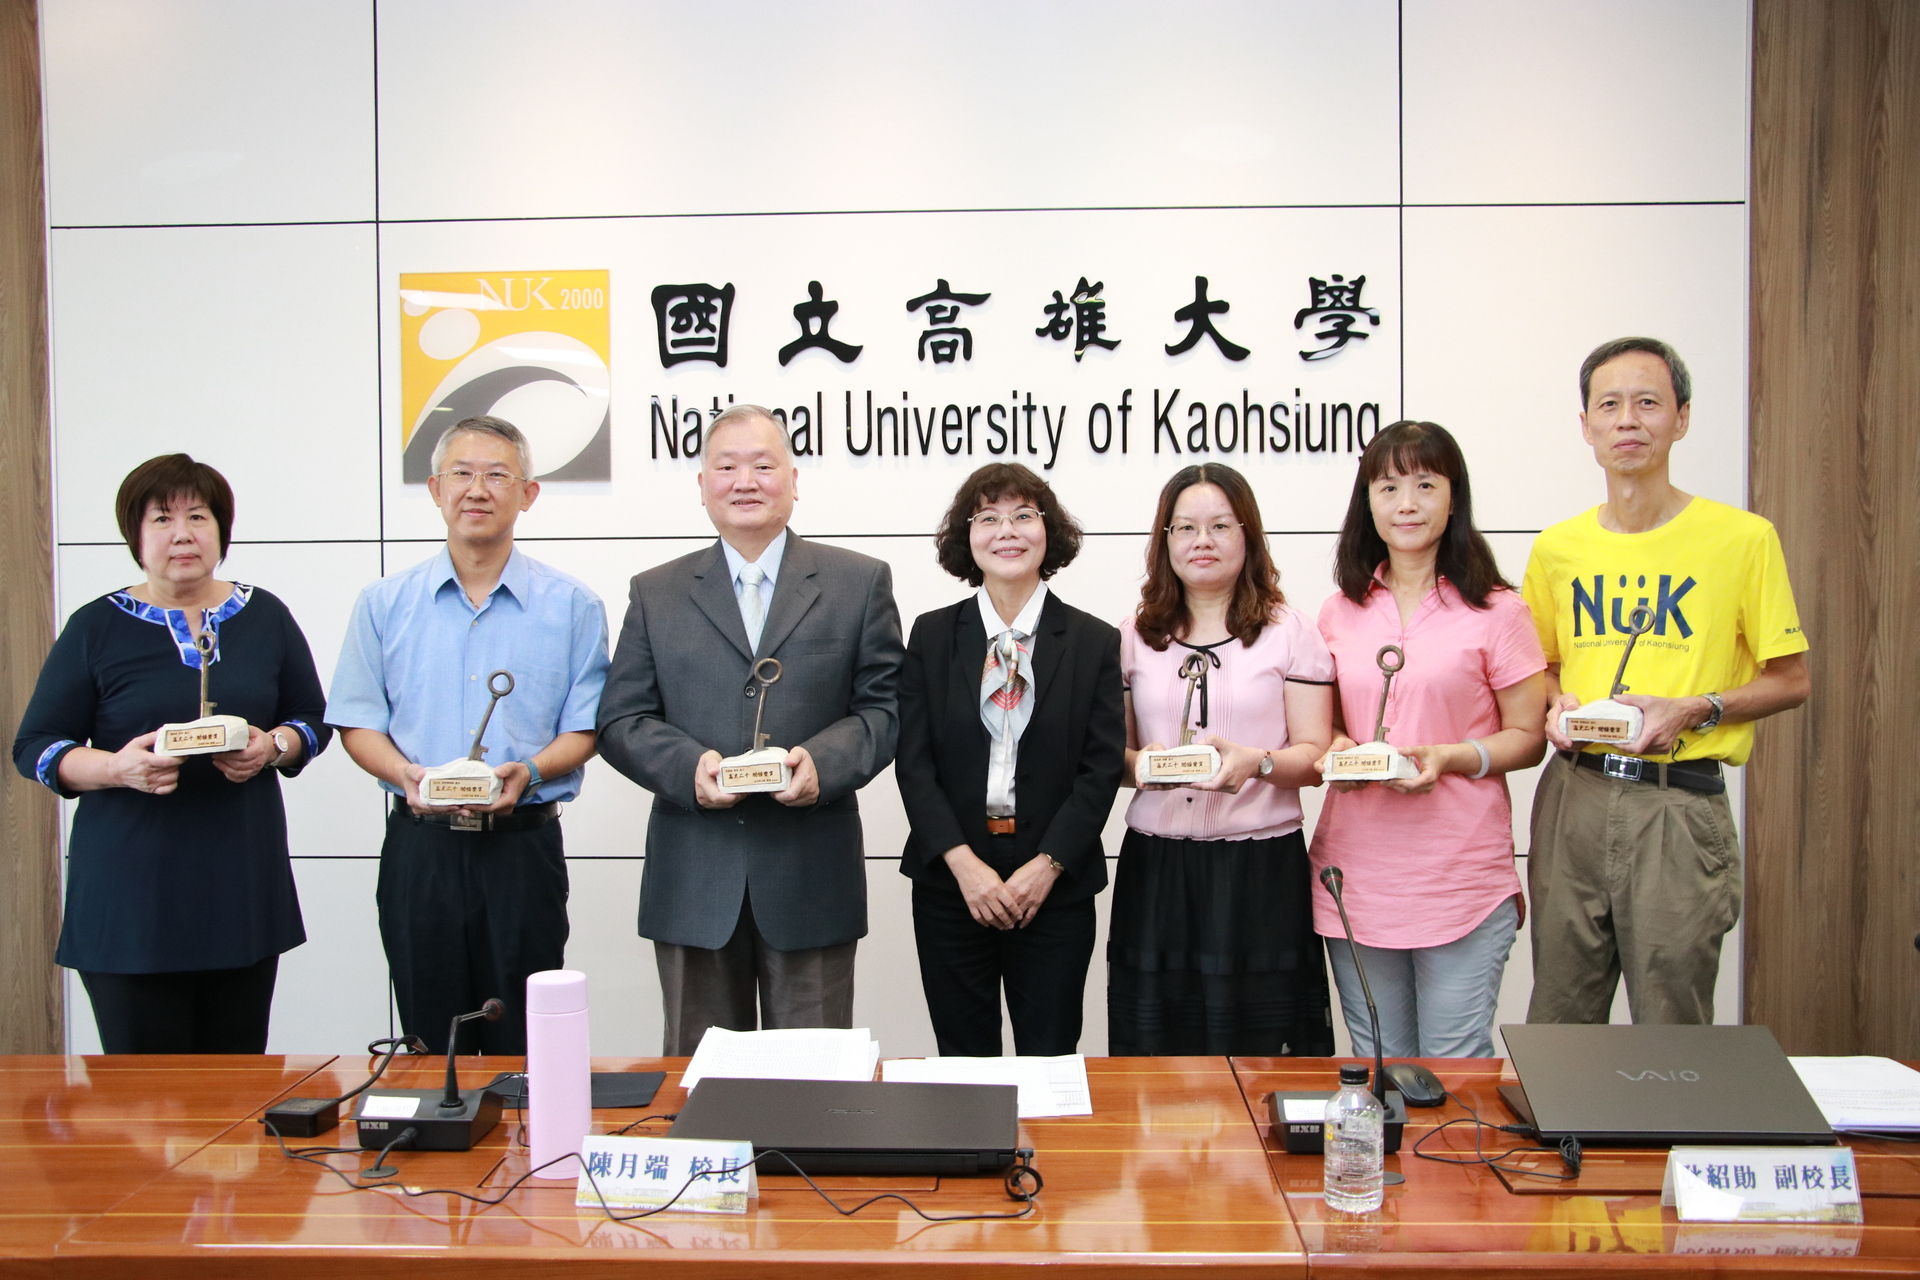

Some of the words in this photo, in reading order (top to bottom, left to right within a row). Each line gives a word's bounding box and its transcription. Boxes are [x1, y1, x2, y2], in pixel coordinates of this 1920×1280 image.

[476, 277, 556, 311] NUK
[560, 288, 604, 310] 2000
[651, 273, 1382, 369] 國立高雄大學
[845, 387, 1067, 471] University
[1088, 388, 1133, 454] of
[1573, 640, 1602, 649] National
[1647, 640, 1690, 652] Kaohsiung
[1616, 1069, 1700, 1082] VAIO
[588, 1151, 669, 1180] 陳月端
[688, 1156, 742, 1184] 校長
[1773, 1164, 1853, 1191] 副校長
